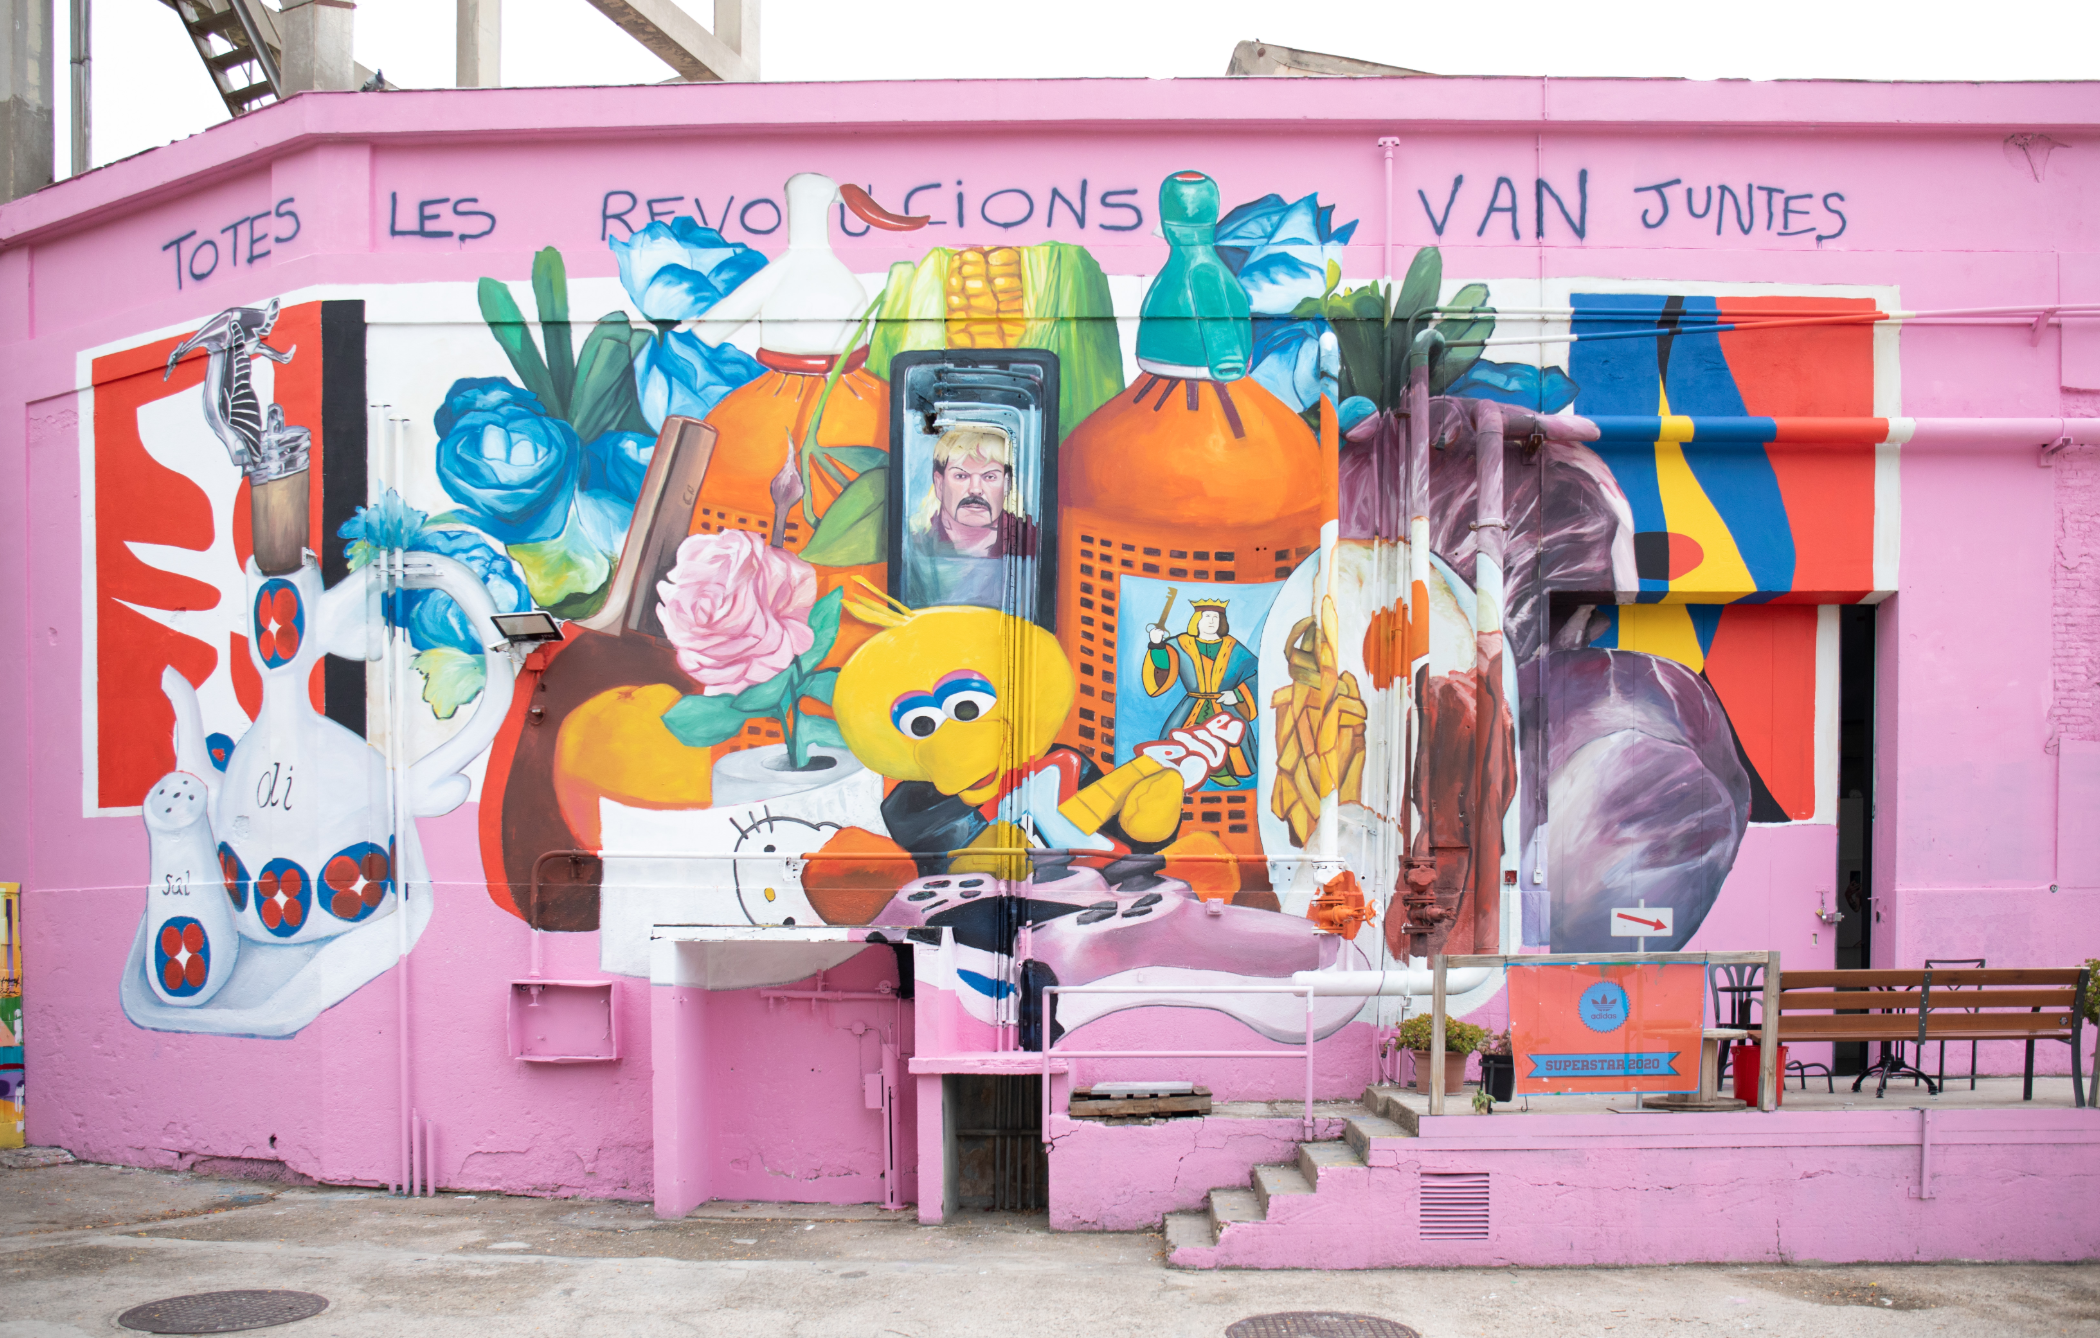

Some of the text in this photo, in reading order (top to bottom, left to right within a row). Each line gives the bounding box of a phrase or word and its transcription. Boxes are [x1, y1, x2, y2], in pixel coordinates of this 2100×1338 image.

[162, 197, 301, 290] TOTES
[390, 191, 497, 244] LES
[1418, 168, 1588, 242] VAN
[1634, 178, 1847, 244] JUNTES
[257, 762, 293, 811] di
[162, 869, 191, 896] sal
[1590, 1012, 1617, 1020] adidas
[1545, 1058, 1660, 1071] SUPERSTAR 2020
